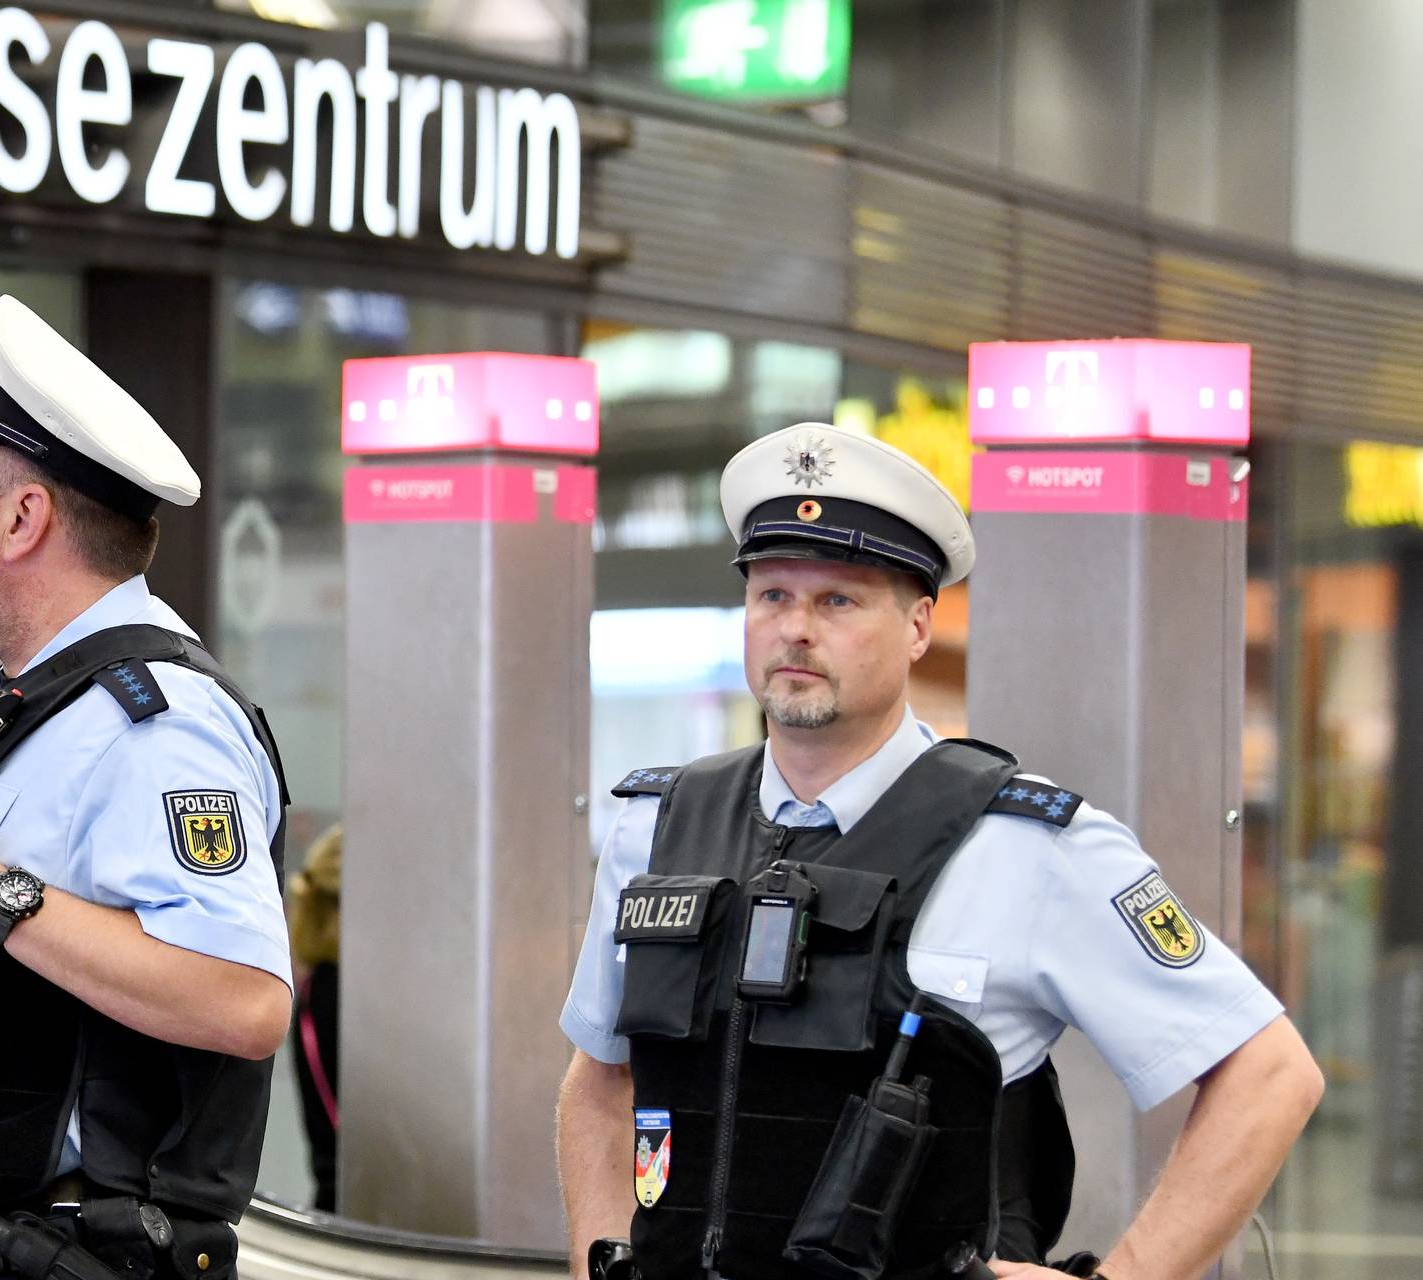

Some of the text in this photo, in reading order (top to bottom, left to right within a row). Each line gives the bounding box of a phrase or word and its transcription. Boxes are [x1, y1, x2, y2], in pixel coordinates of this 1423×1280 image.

[1028, 466, 1104, 487] HOTSPOT
[173, 796, 233, 813] POLIZEI
[1123, 879, 1168, 916] POLIZEI
[620, 894, 698, 931] POLIZEI
